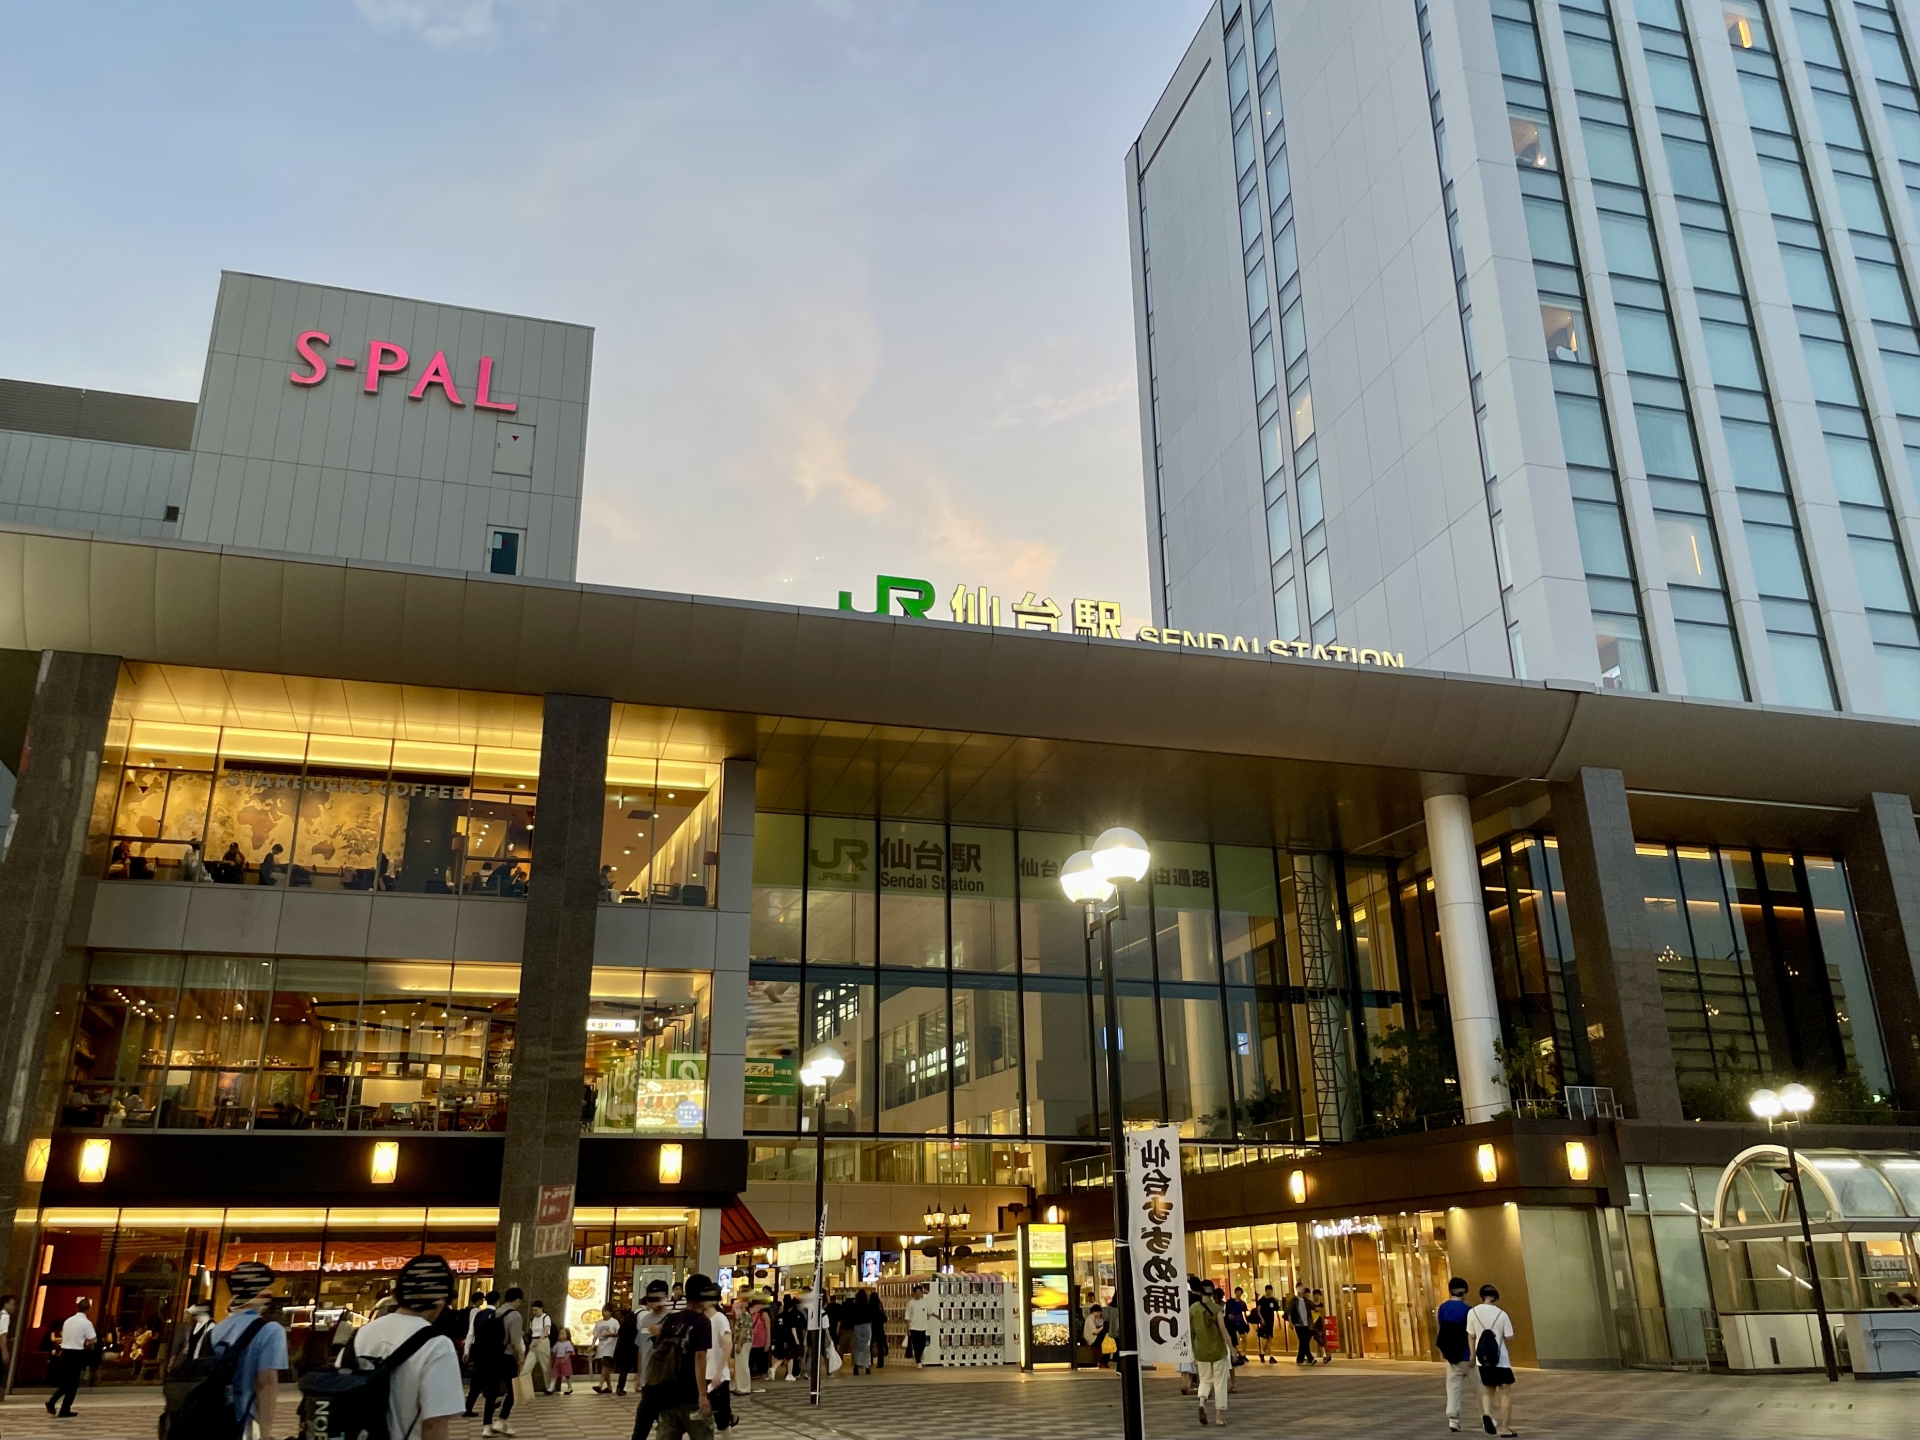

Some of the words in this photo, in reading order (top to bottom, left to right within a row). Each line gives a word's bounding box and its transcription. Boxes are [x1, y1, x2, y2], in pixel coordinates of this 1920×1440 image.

[290, 330, 517, 414] S-PAL
[839, 575, 936, 619] JR
[950, 584, 1122, 639] 仙台駅
[1137, 626, 1260, 654] SENDAI
[1267, 639, 1405, 668] STATION
[226, 771, 373, 795] STARBUCKS
[377, 781, 465, 800] COFFEE
[810, 837, 869, 871] JR
[881, 837, 982, 873] 仙台駅
[881, 872, 927, 890] Sendai
[931, 874, 985, 892] Station
